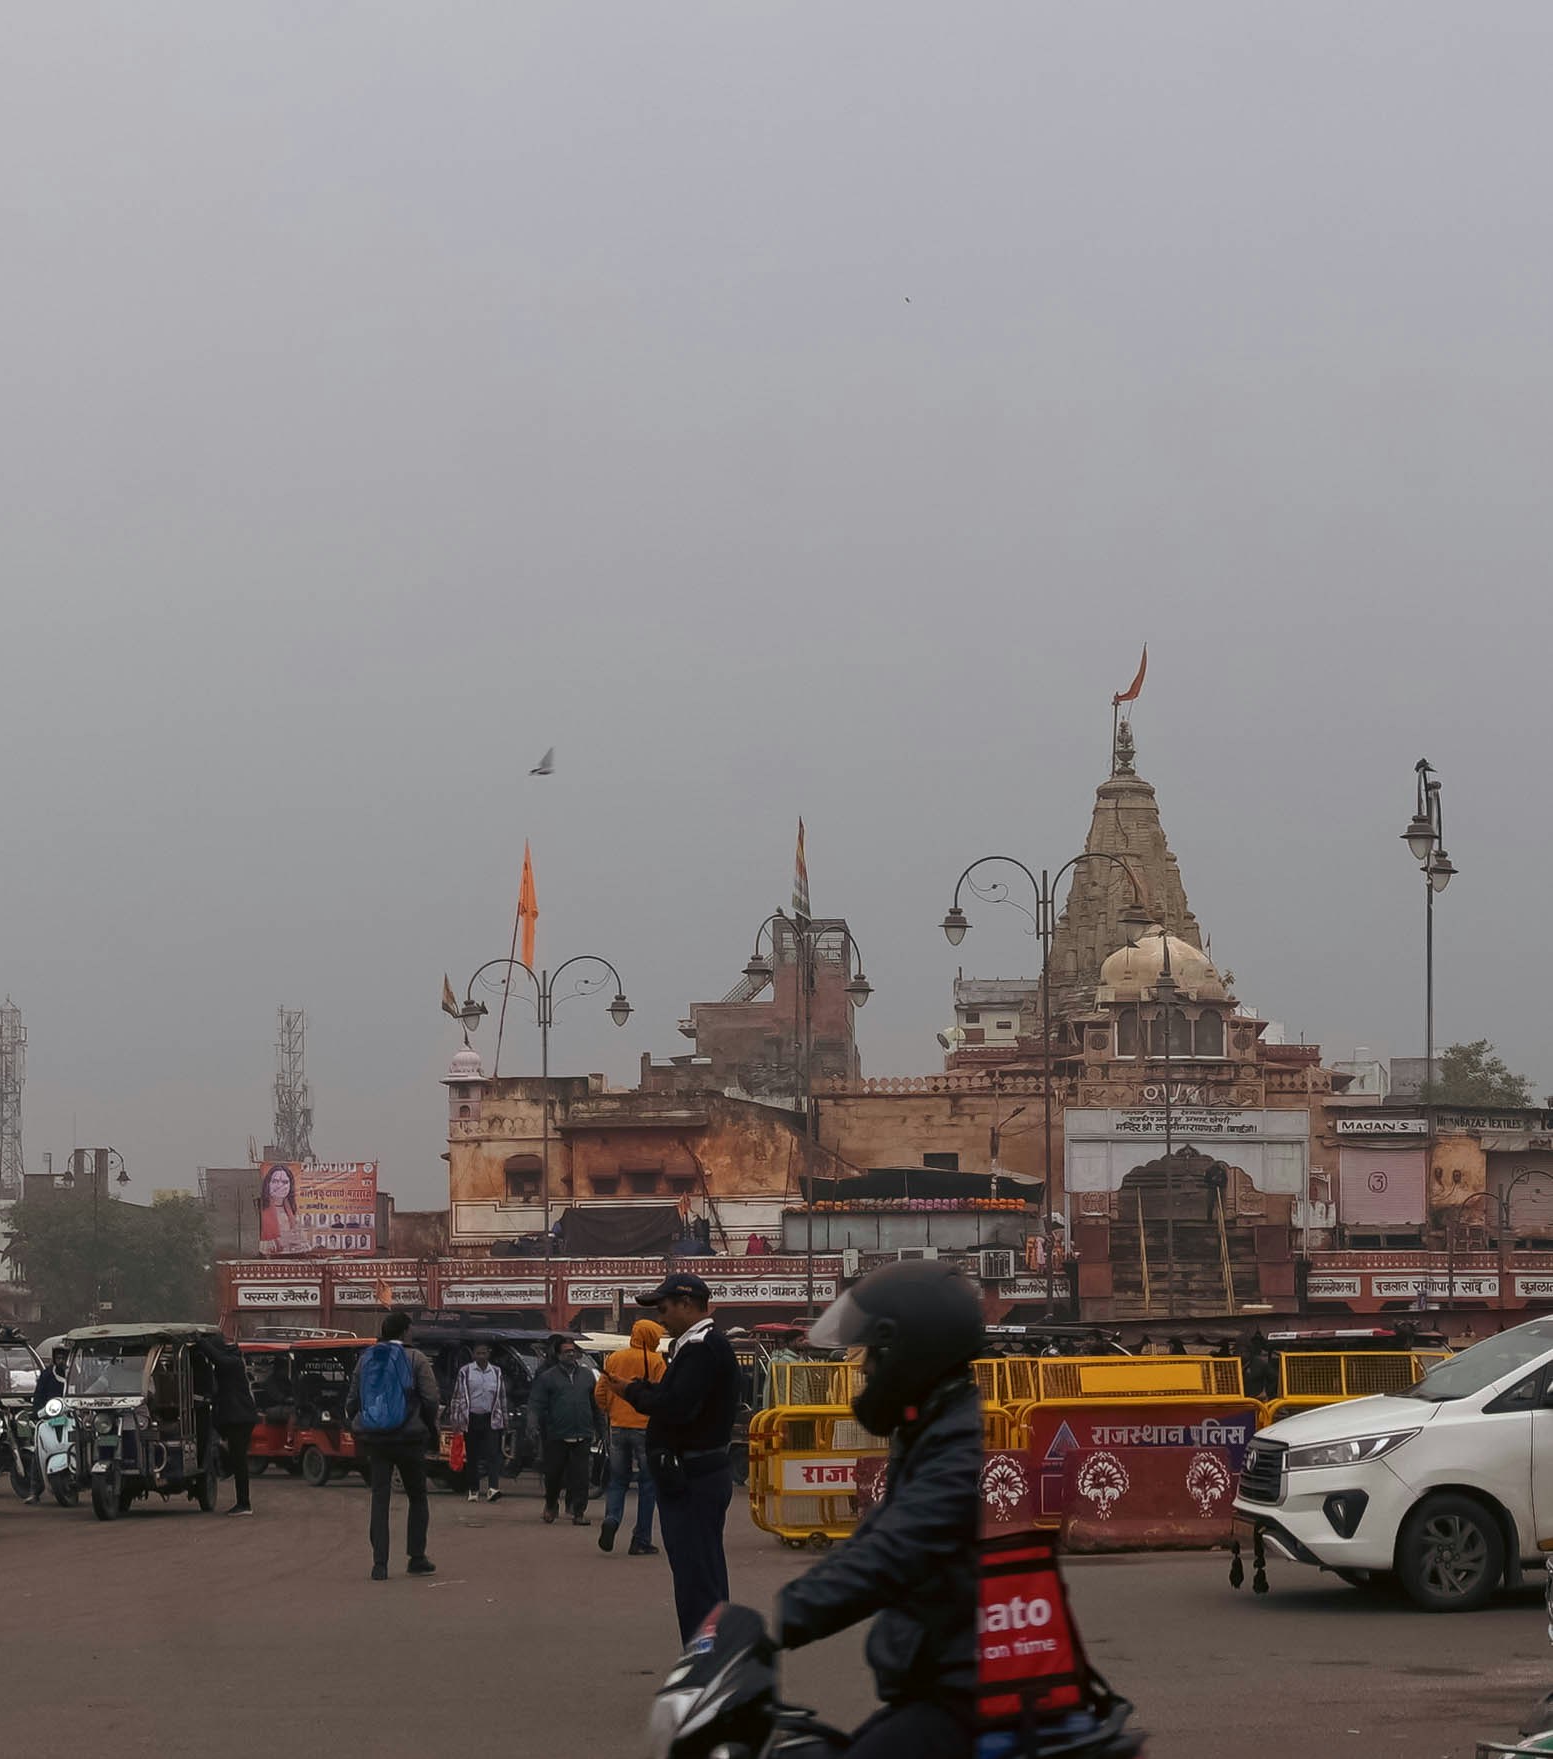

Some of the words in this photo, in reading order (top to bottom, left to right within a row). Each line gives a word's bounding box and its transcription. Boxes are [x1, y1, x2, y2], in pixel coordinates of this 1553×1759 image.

[1091, 1425, 1185, 1445] राजस्थान
[1190, 1417, 1246, 1449] पुलिस
[1013, 1637, 1057, 1656] time
